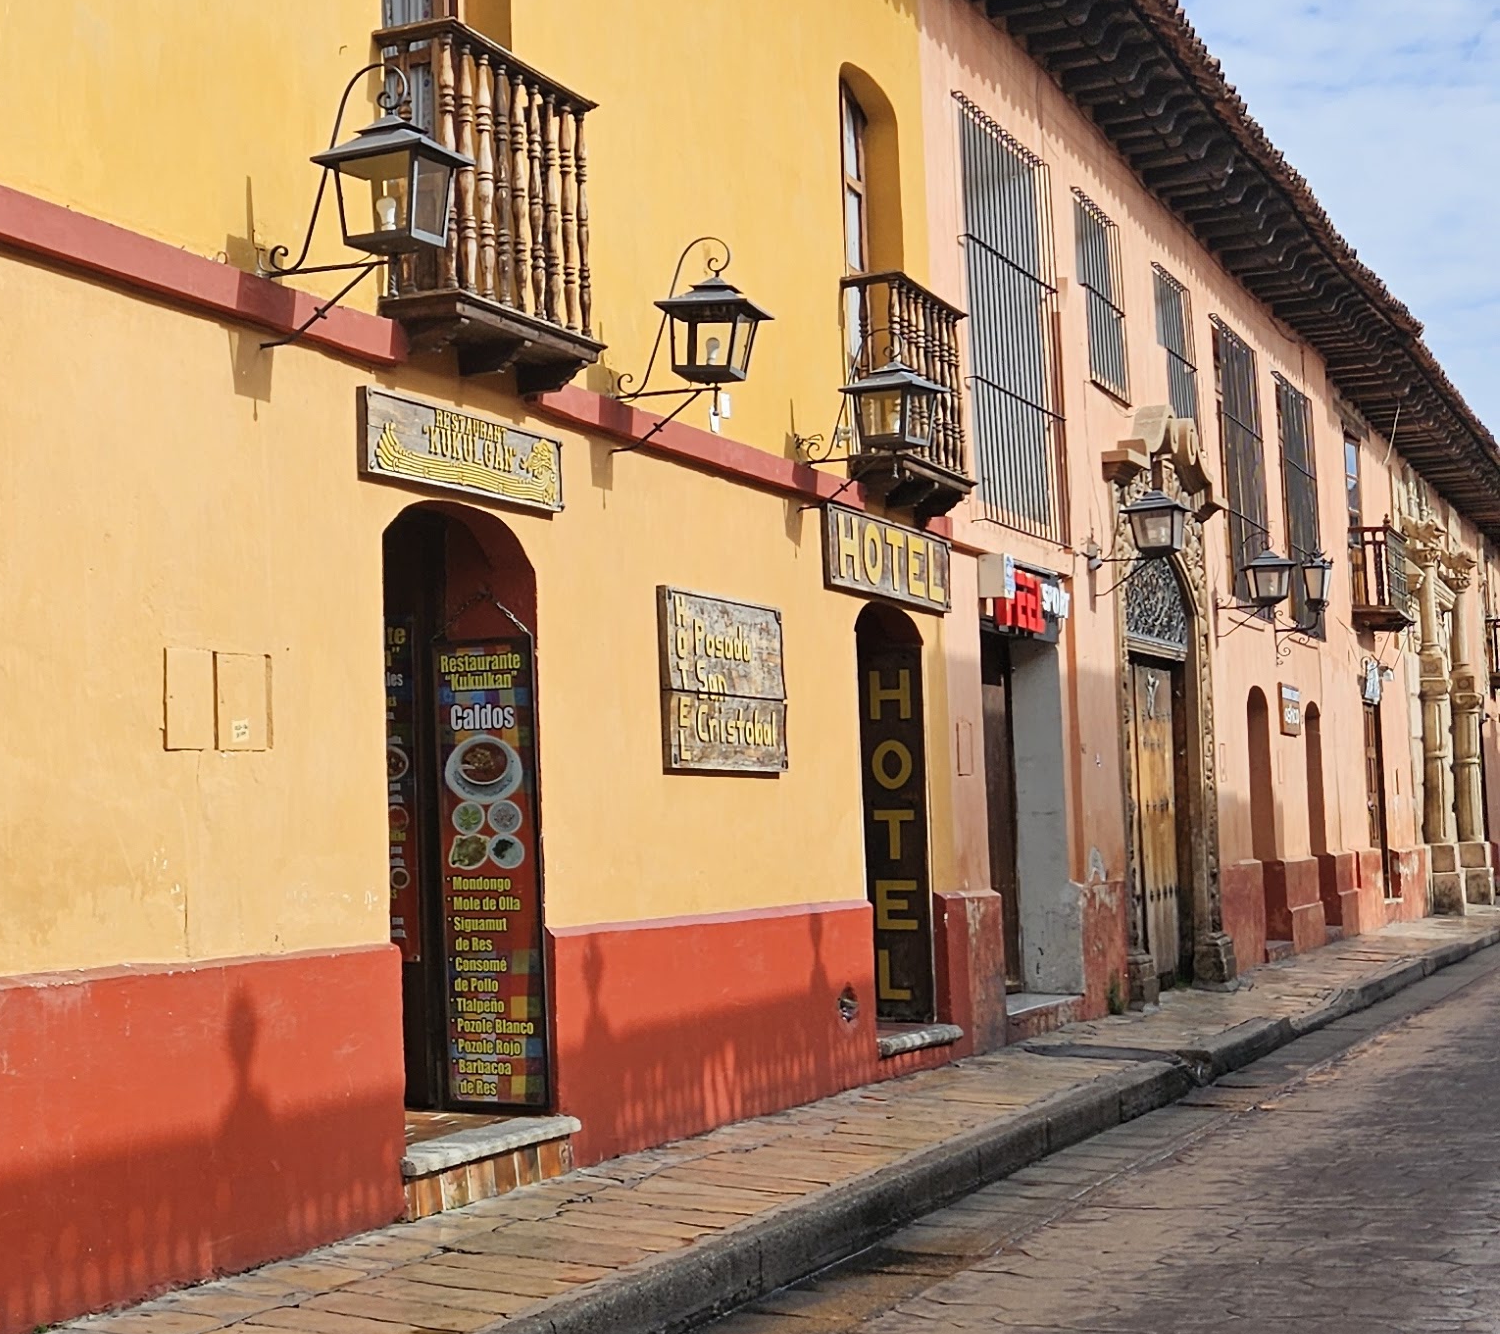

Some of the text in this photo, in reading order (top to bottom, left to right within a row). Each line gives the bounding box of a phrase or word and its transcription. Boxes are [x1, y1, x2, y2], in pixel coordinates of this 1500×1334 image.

[836, 512, 945, 605] HOTEL
[693, 618, 751, 663] Posada
[441, 653, 521, 673] Restaurante
[673, 595, 692, 762] HOTEL
[695, 659, 728, 703] San
[451, 704, 515, 731] Caldos
[696, 704, 777, 748] Cristobal
[868, 668, 919, 1001] HOTEL
[453, 876, 511, 892] Mondongo
[453, 896, 520, 911] Mole de Olla
[453, 916, 507, 933] Siguamut
[455, 936, 493, 951] de Res
[455, 956, 507, 972] Consomé
[454, 977, 499, 992] de Pollo
[456, 997, 505, 1014] Tlalpeño
[457, 1017, 534, 1035] Pozole Blanco
[457, 1038, 521, 1056] Pozole Rojo
[458, 1058, 512, 1076] Barbacoa
[460, 1079, 497, 1095] de Res
